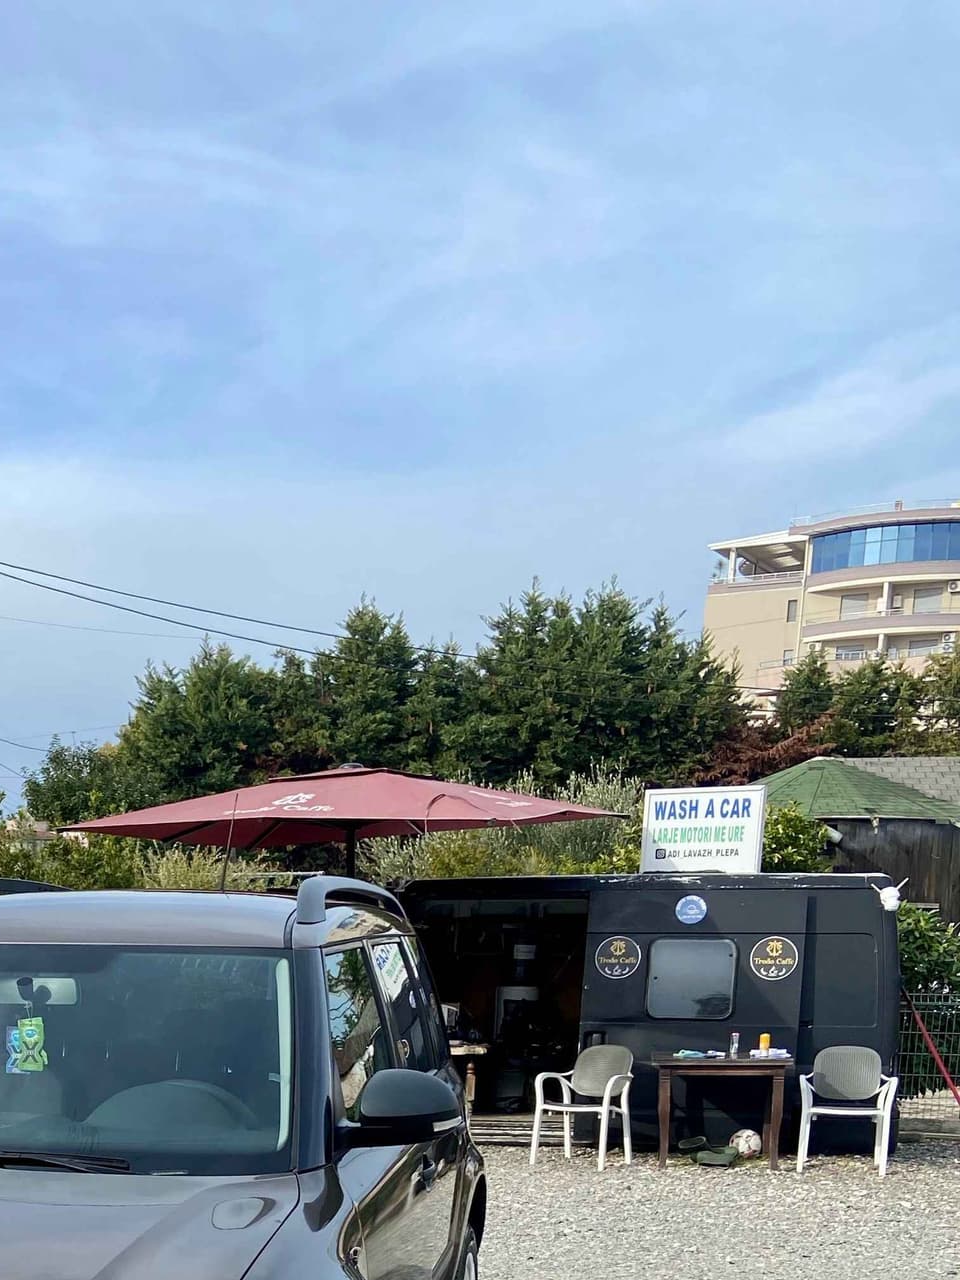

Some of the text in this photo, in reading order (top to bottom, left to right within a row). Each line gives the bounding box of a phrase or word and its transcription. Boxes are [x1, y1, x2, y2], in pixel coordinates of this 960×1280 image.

[654, 798, 751, 820] WASH A CAR
[680, 826, 713, 844] MOTORI
[714, 826, 726, 843] ME
[728, 826, 745, 842] URE
